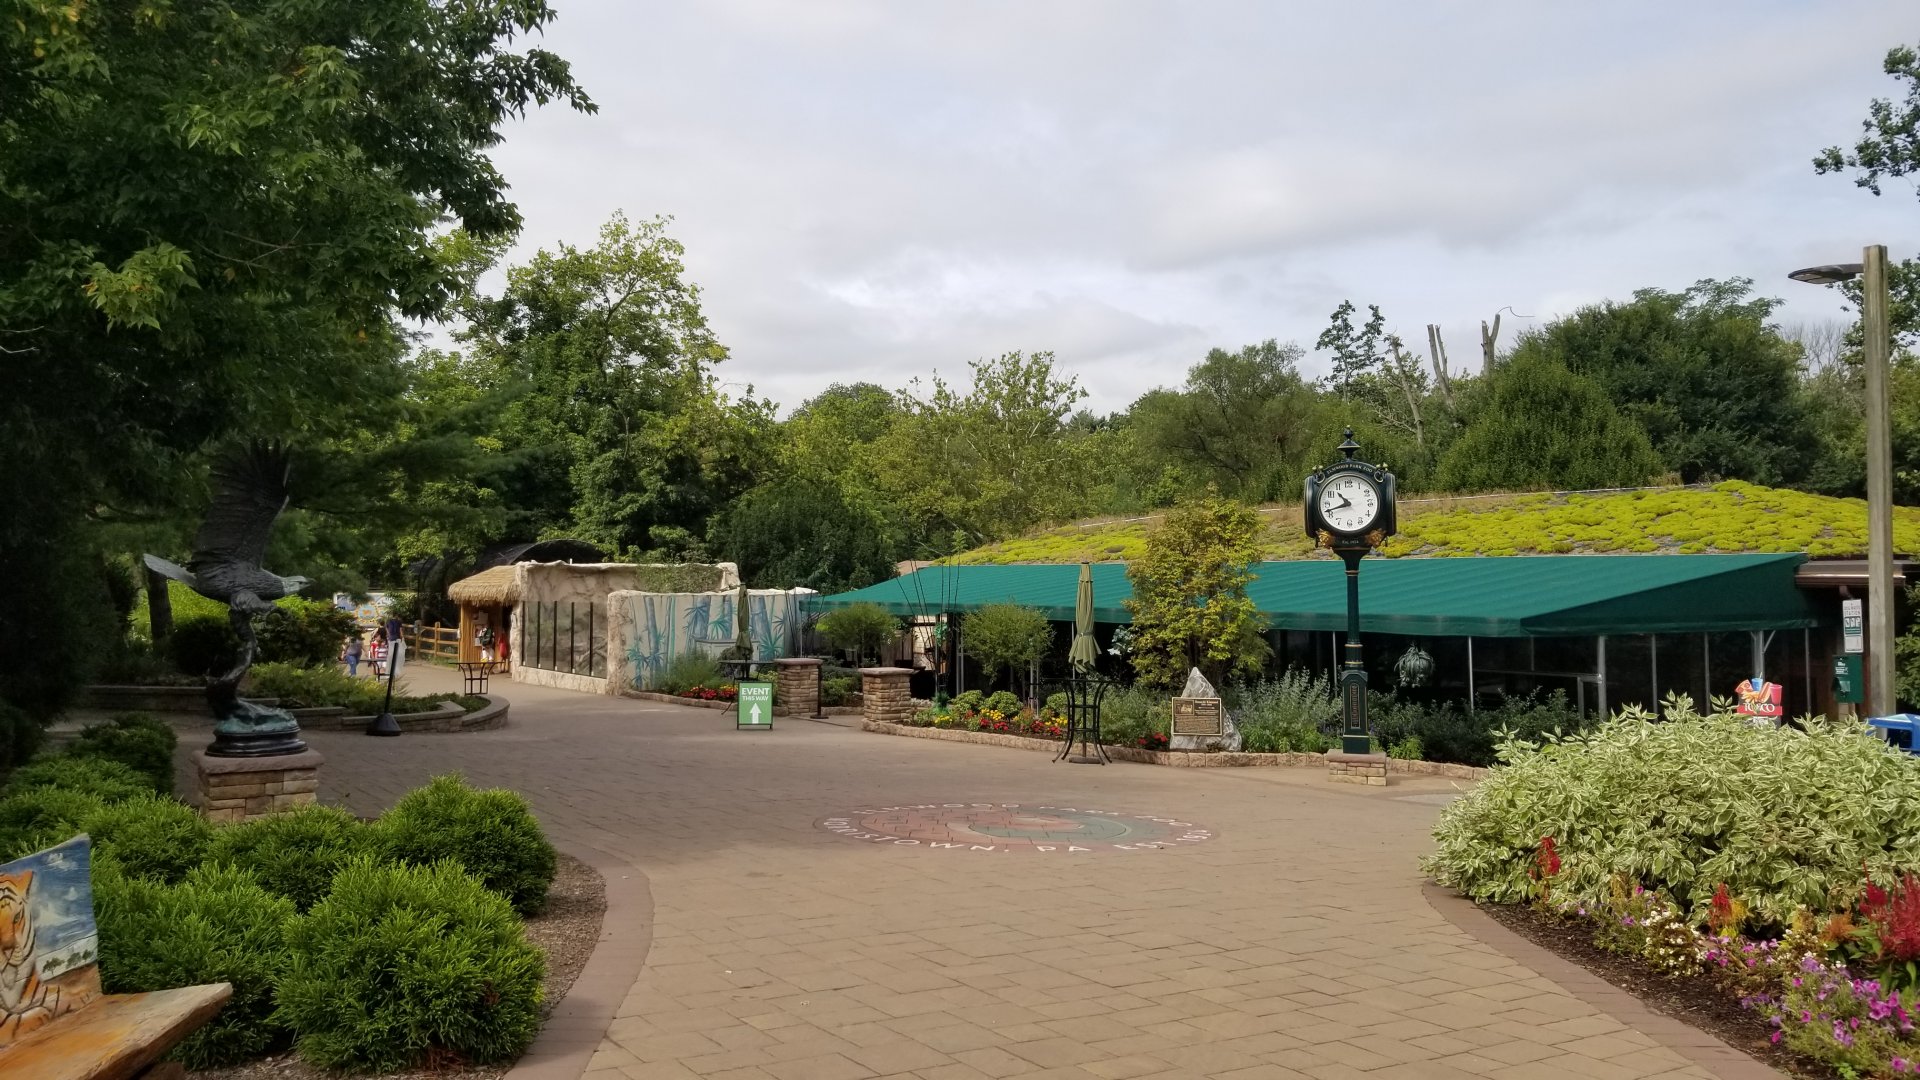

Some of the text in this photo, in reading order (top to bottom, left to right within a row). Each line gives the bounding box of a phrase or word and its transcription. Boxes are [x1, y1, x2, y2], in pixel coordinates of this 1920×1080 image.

[1365, 509, 1371, 517] 4
[1335, 517, 1342, 525] 7
[742, 687, 770, 695] EVENT
